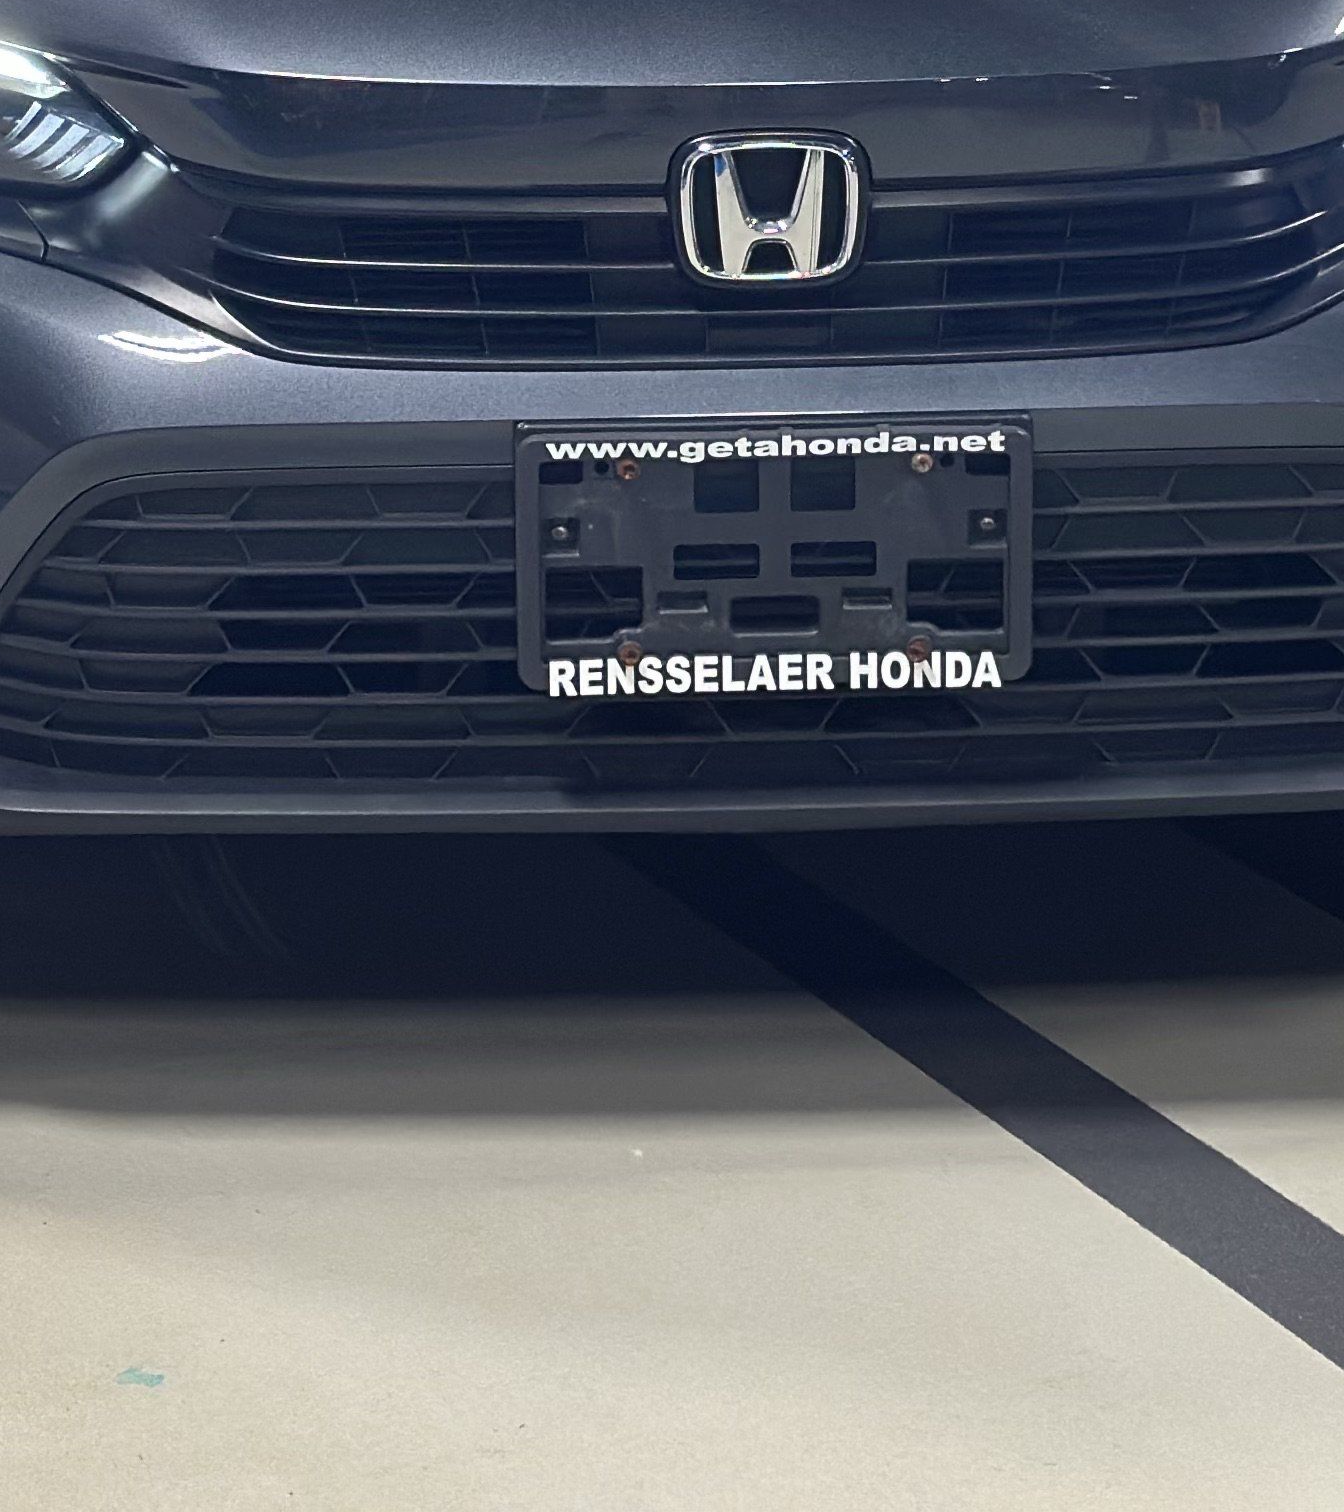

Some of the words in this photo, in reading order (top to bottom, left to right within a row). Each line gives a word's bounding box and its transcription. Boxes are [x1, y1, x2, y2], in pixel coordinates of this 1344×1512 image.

[545, 429, 1006, 463] www.getahonda.net
[548, 653, 835, 697] RENSSELAER
[849, 650, 1002, 690] HONDA
